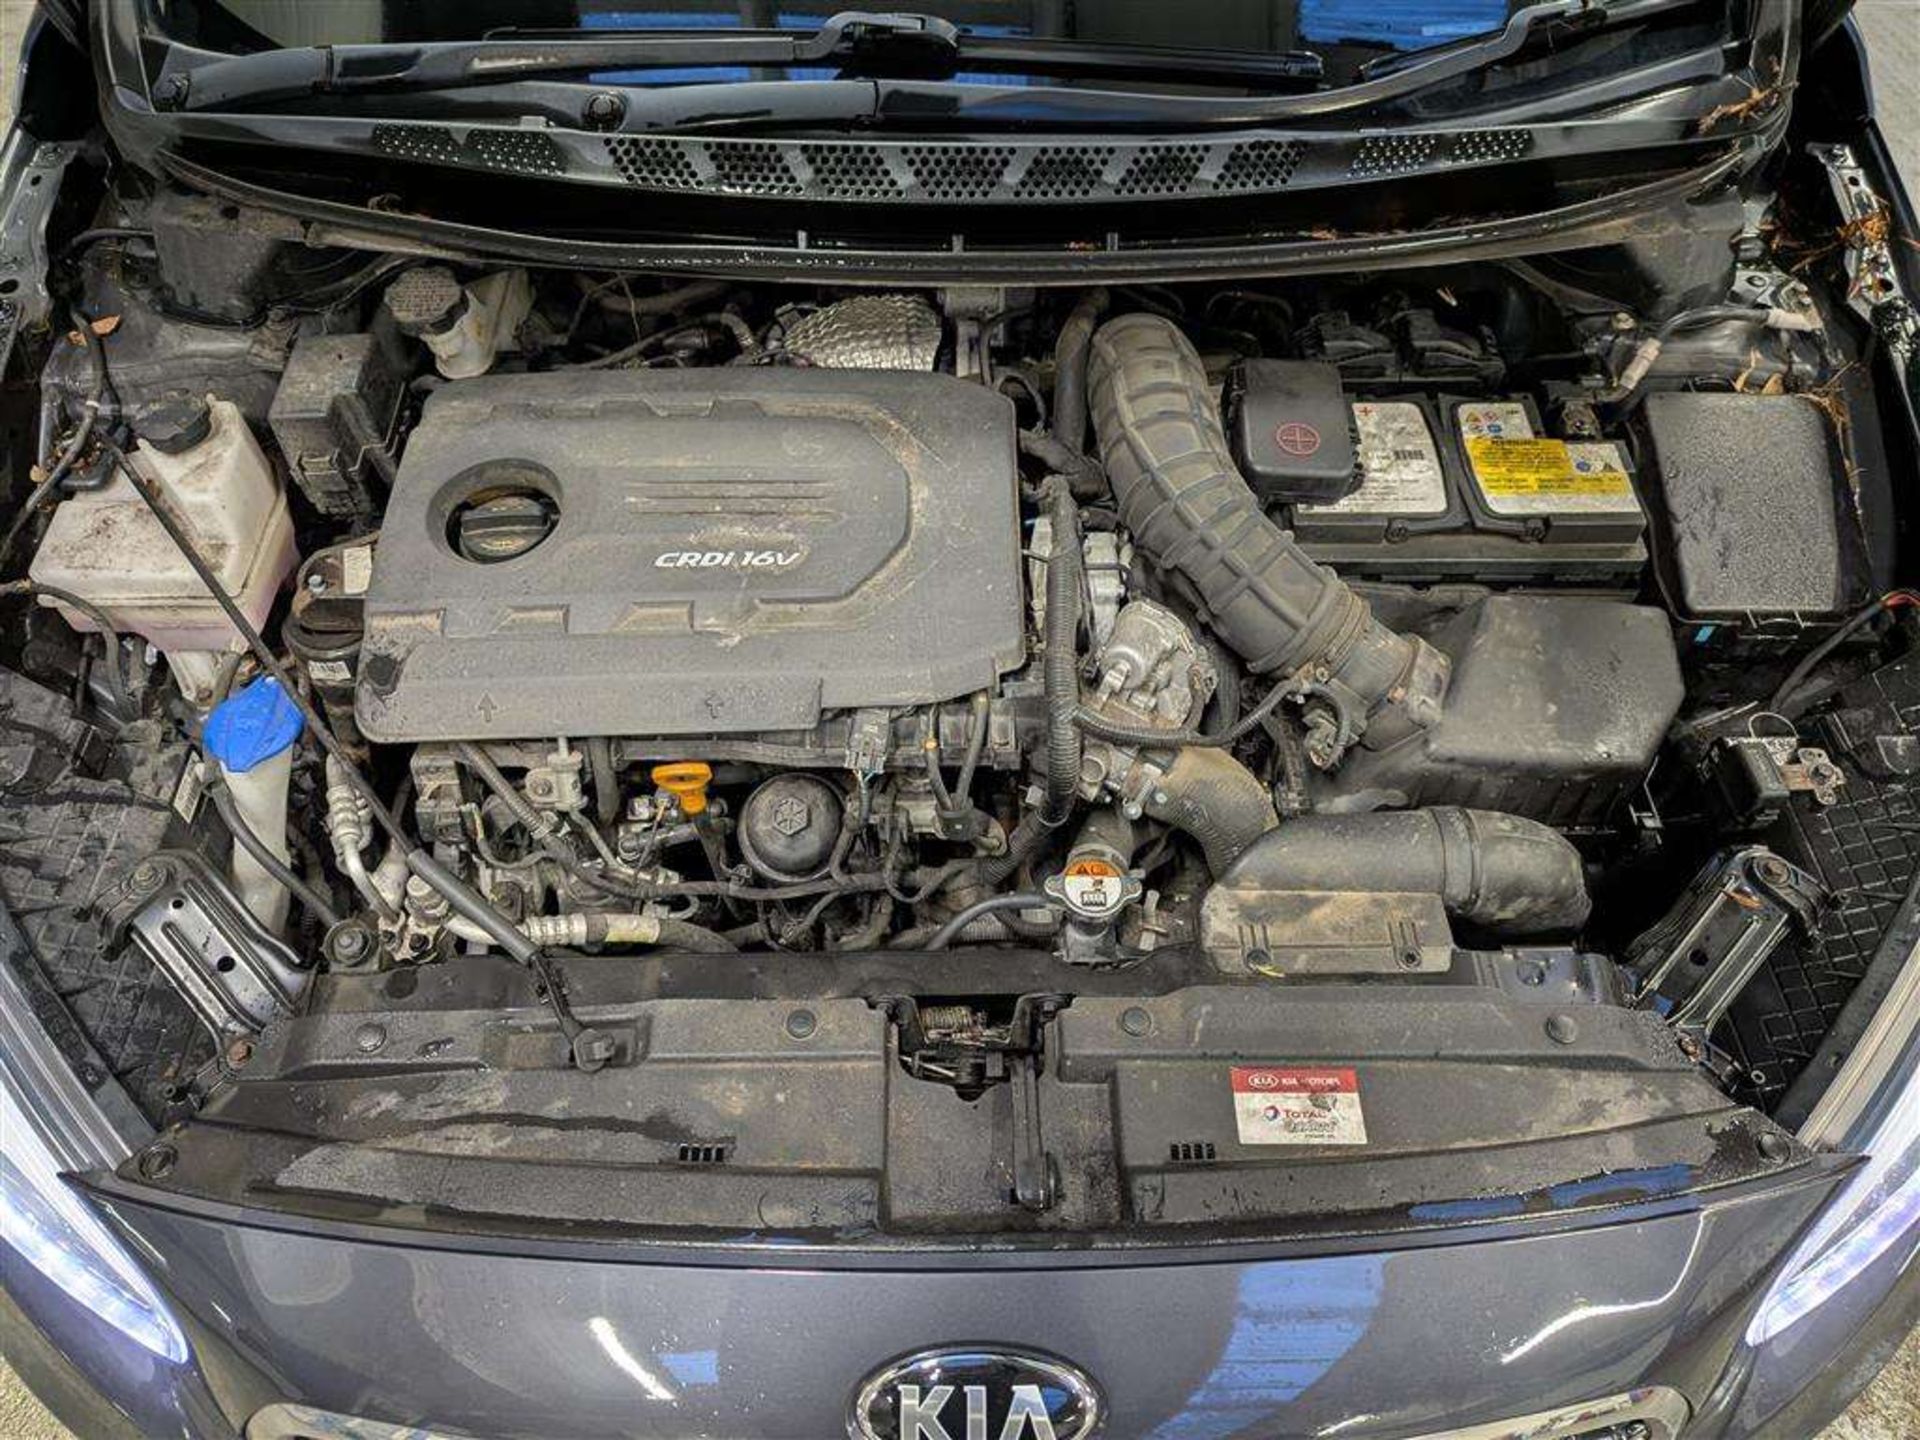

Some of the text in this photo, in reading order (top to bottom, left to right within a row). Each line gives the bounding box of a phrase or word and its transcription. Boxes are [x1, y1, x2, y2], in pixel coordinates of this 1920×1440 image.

[655, 550, 800, 567] CRDI 16V
[1281, 1076, 1298, 1085] KIA
[1282, 1109, 1328, 1119] TOTAL
[897, 1384, 1057, 1440] KIA
